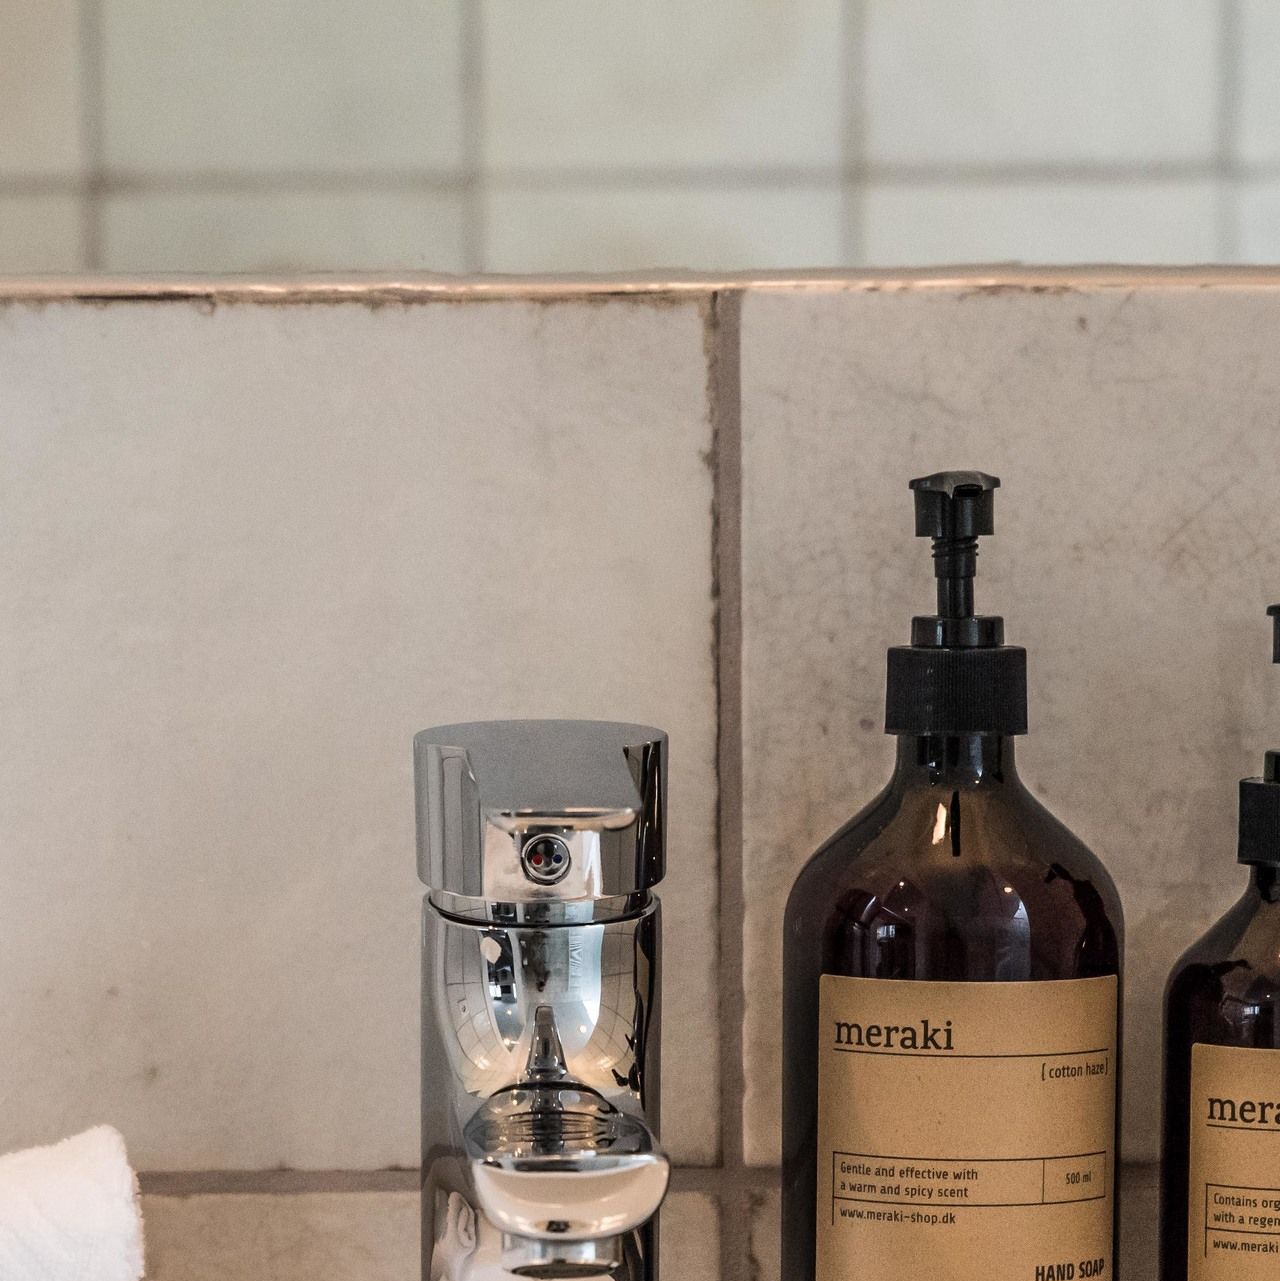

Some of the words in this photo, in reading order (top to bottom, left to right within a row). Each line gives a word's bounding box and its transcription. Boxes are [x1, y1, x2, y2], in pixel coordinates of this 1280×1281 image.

[834, 1020, 954, 1051] meraki
[1048, 1063, 1083, 1079] cotton
[840, 1161, 872, 1177] Gentle
[874, 1166, 895, 1178] and
[899, 1166, 949, 1181] effective
[952, 1168, 979, 1181] with
[1065, 1173, 1080, 1185] 500
[1082, 1171, 1092, 1183] ml
[840, 1182, 846, 1191] a
[849, 1182, 877, 1194] warm
[880, 1183, 901, 1196] and
[904, 1185, 934, 1199] spicy
[937, 1185, 968, 1199] scent
[1214, 1193, 1258, 1209] Contains
[840, 1208, 956, 1226] www.meraki-shop.dk
[1213, 1212, 1236, 1224] with
[1238, 1216, 1245, 1225] a
[1078, 1258, 1105, 1279] SOAP
